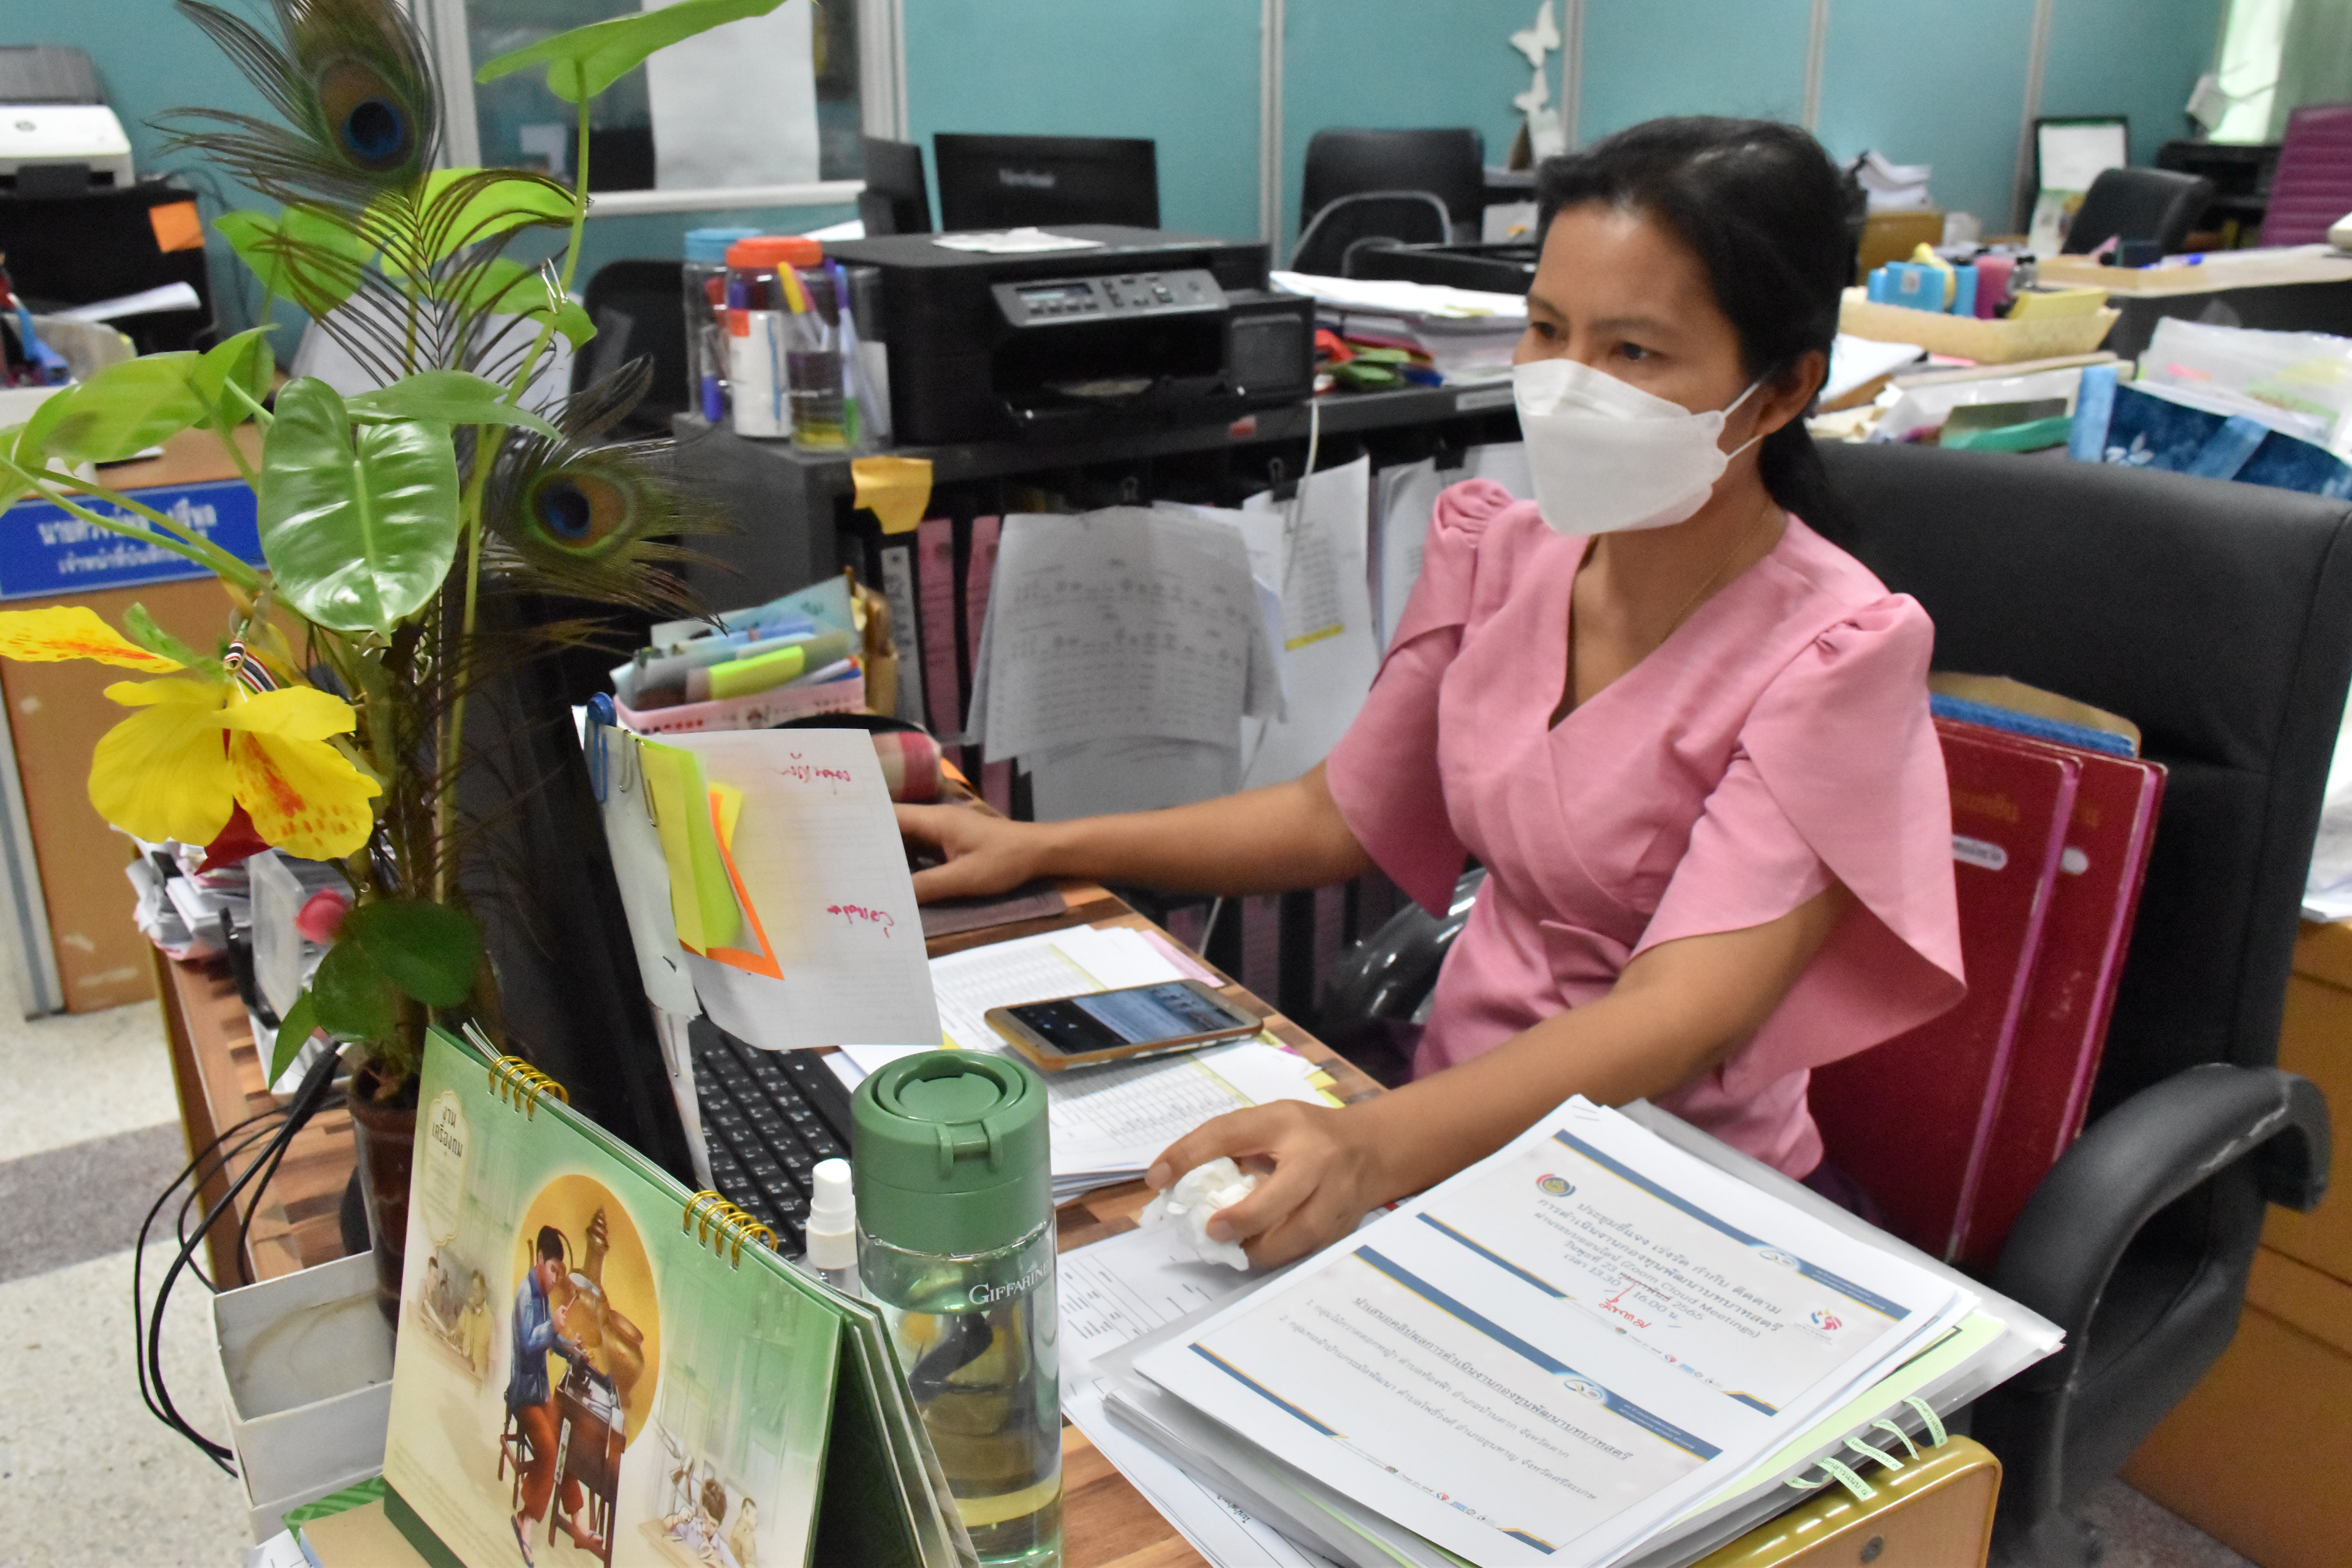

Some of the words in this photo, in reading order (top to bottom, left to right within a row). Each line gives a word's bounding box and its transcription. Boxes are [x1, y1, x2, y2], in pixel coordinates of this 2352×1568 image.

[443, 1106, 457, 1128] งาน
[969, 1259, 1048, 1305] GIFFARIN
[1588, 1267, 1621, 1286] 13.30
[1632, 1291, 1668, 1312] 16.00
[1601, 1262, 1618, 1272] 23
[1671, 1301, 1705, 1320] 2565
[1620, 1261, 1659, 1283] (Zoom
[1661, 1282, 1699, 1304] Cloud
[1699, 1303, 1760, 1338] Meetings)
